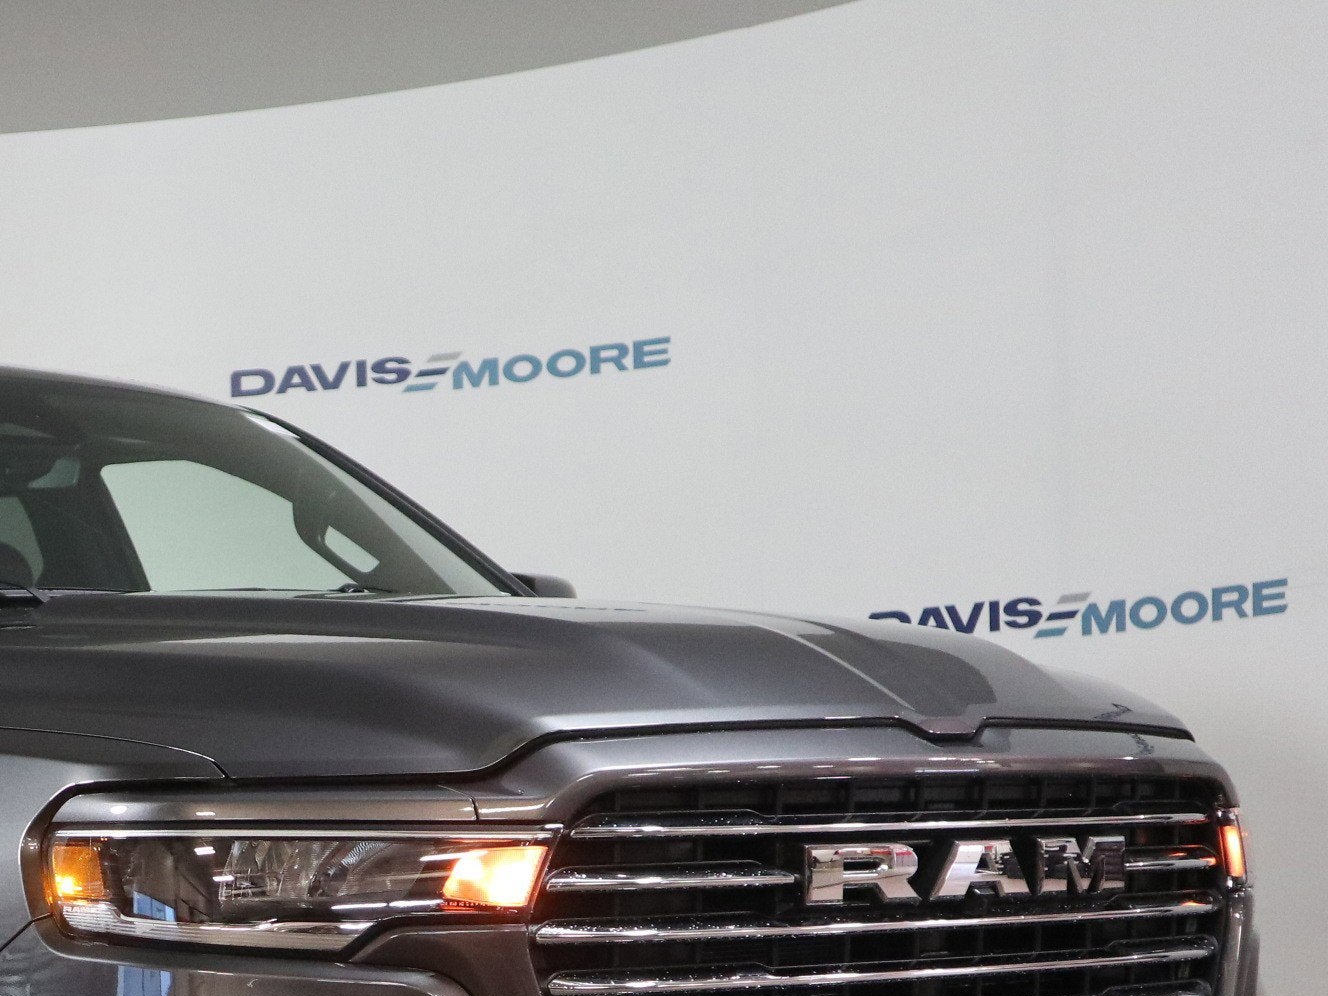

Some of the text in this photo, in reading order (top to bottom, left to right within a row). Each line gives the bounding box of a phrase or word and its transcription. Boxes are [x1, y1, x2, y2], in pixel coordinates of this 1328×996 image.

[230, 336, 671, 398] DAVIS MOORE
[1081, 577, 1289, 636] MOORE
[803, 835, 1125, 905] RAM
